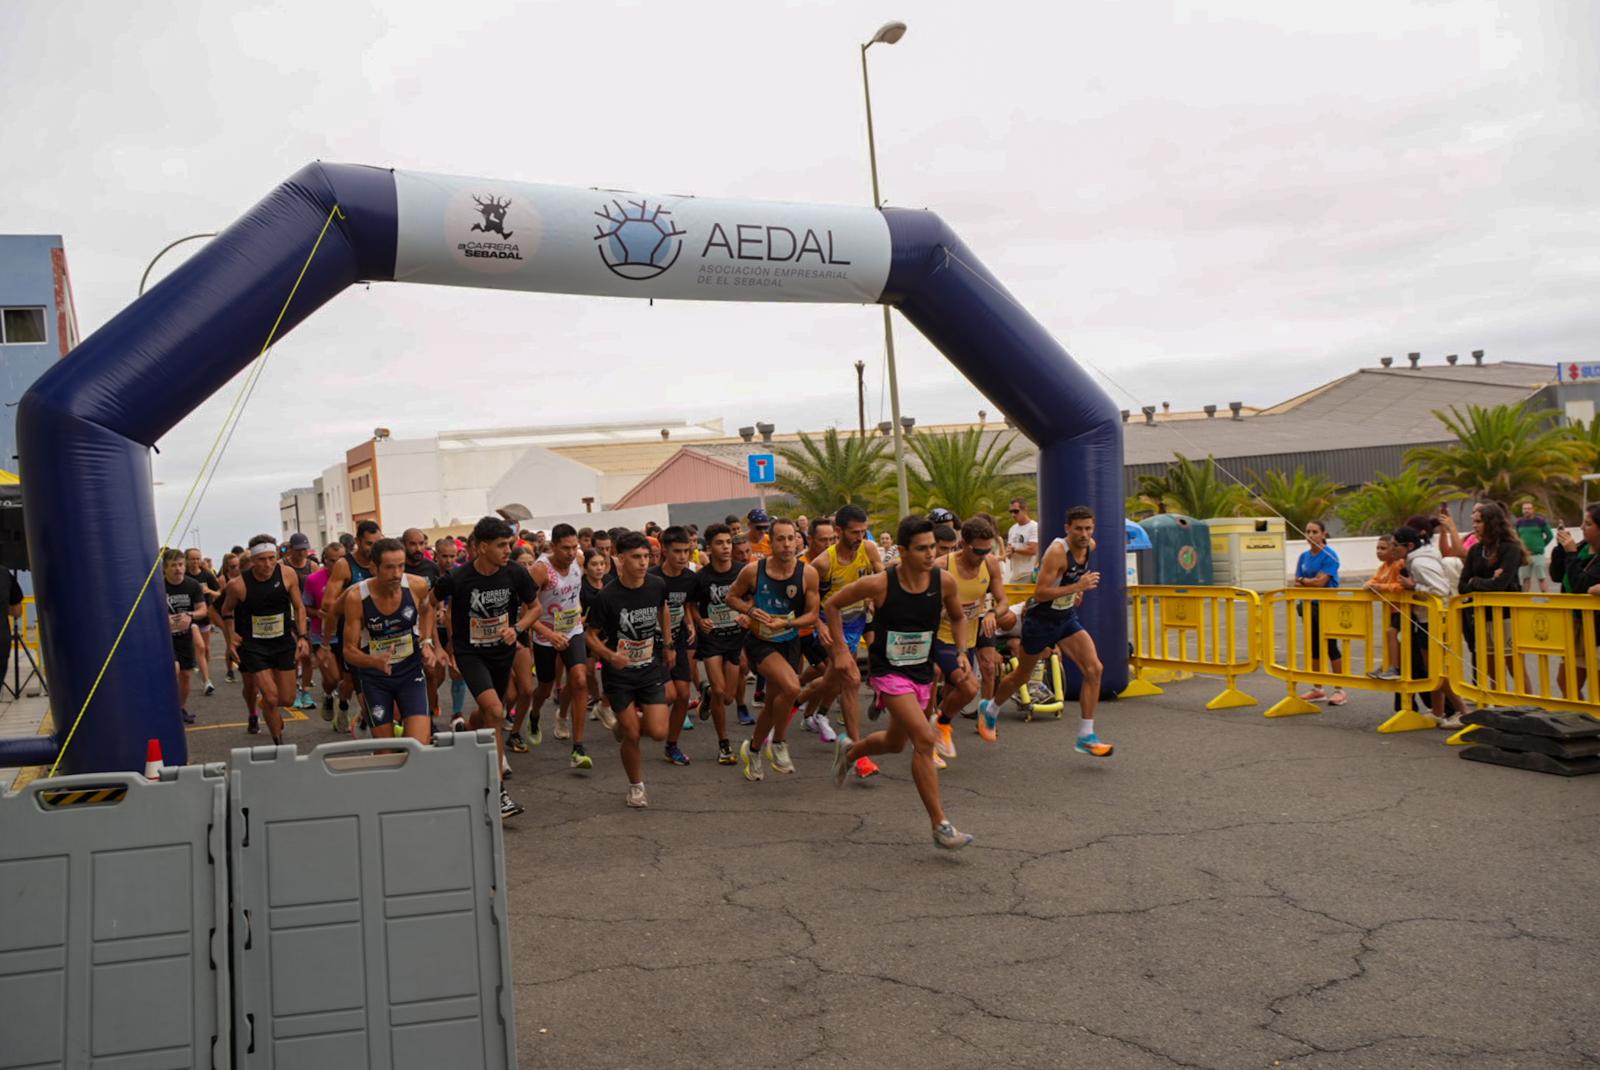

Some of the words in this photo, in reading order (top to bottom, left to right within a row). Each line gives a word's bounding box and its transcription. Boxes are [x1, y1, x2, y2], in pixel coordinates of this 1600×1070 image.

[466, 241, 520, 251] CARRERA
[701, 222, 851, 265] AEDAL
[464, 249, 523, 260] SEBADAL
[698, 264, 772, 277] ASOCIACIÓN
[774, 267, 849, 280] EMPRESARIAL
[697, 275, 713, 285] DE
[716, 276, 730, 286] EL
[734, 276, 784, 288] SEBADAL
[902, 644, 918, 655] 146
